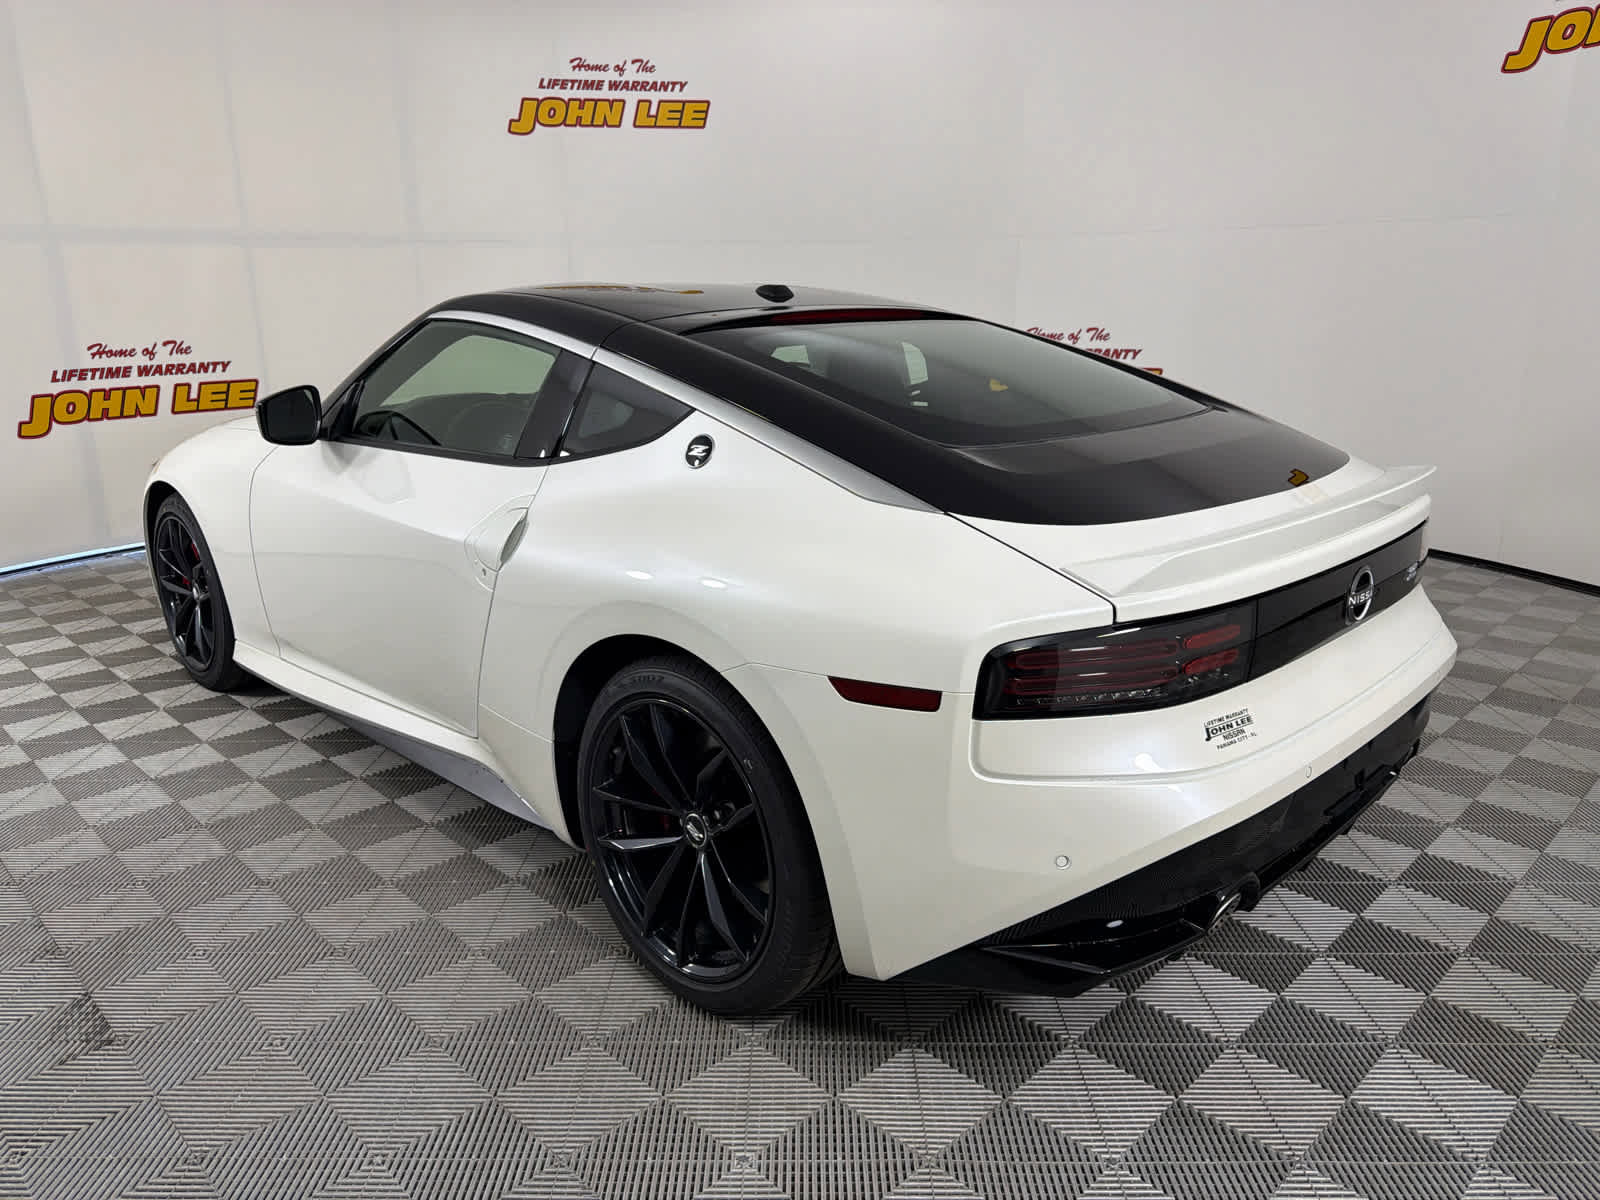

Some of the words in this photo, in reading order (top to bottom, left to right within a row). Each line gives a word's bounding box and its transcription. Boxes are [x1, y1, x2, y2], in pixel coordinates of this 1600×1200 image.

[569, 57, 610, 73] Home
[613, 59, 628, 77] of
[631, 58, 657, 74] The
[538, 78, 605, 92] LIFETIME
[607, 79, 689, 93] WARRANTY
[508, 96, 626, 136] JOHN
[633, 99, 711, 129] LEE
[1068, 328, 1082, 345] of
[1086, 327, 1111, 342] The
[86, 342, 138, 360] Home
[141, 342, 158, 361] of
[162, 340, 193, 357] The
[50, 365, 133, 383] LIFETIME
[136, 360, 232, 379] WARRANTY
[17, 384, 160, 440] JOHN
[171, 378, 259, 414] LEE
[687, 445, 710, 457] Z
[1204, 716, 1224, 726] LIFETIME
[1225, 708, 1248, 720] WARRANTY
[1205, 722, 1234, 742] JOHN
[1235, 716, 1252, 726] LEE
[1222, 728, 1246, 740] NISSAN
